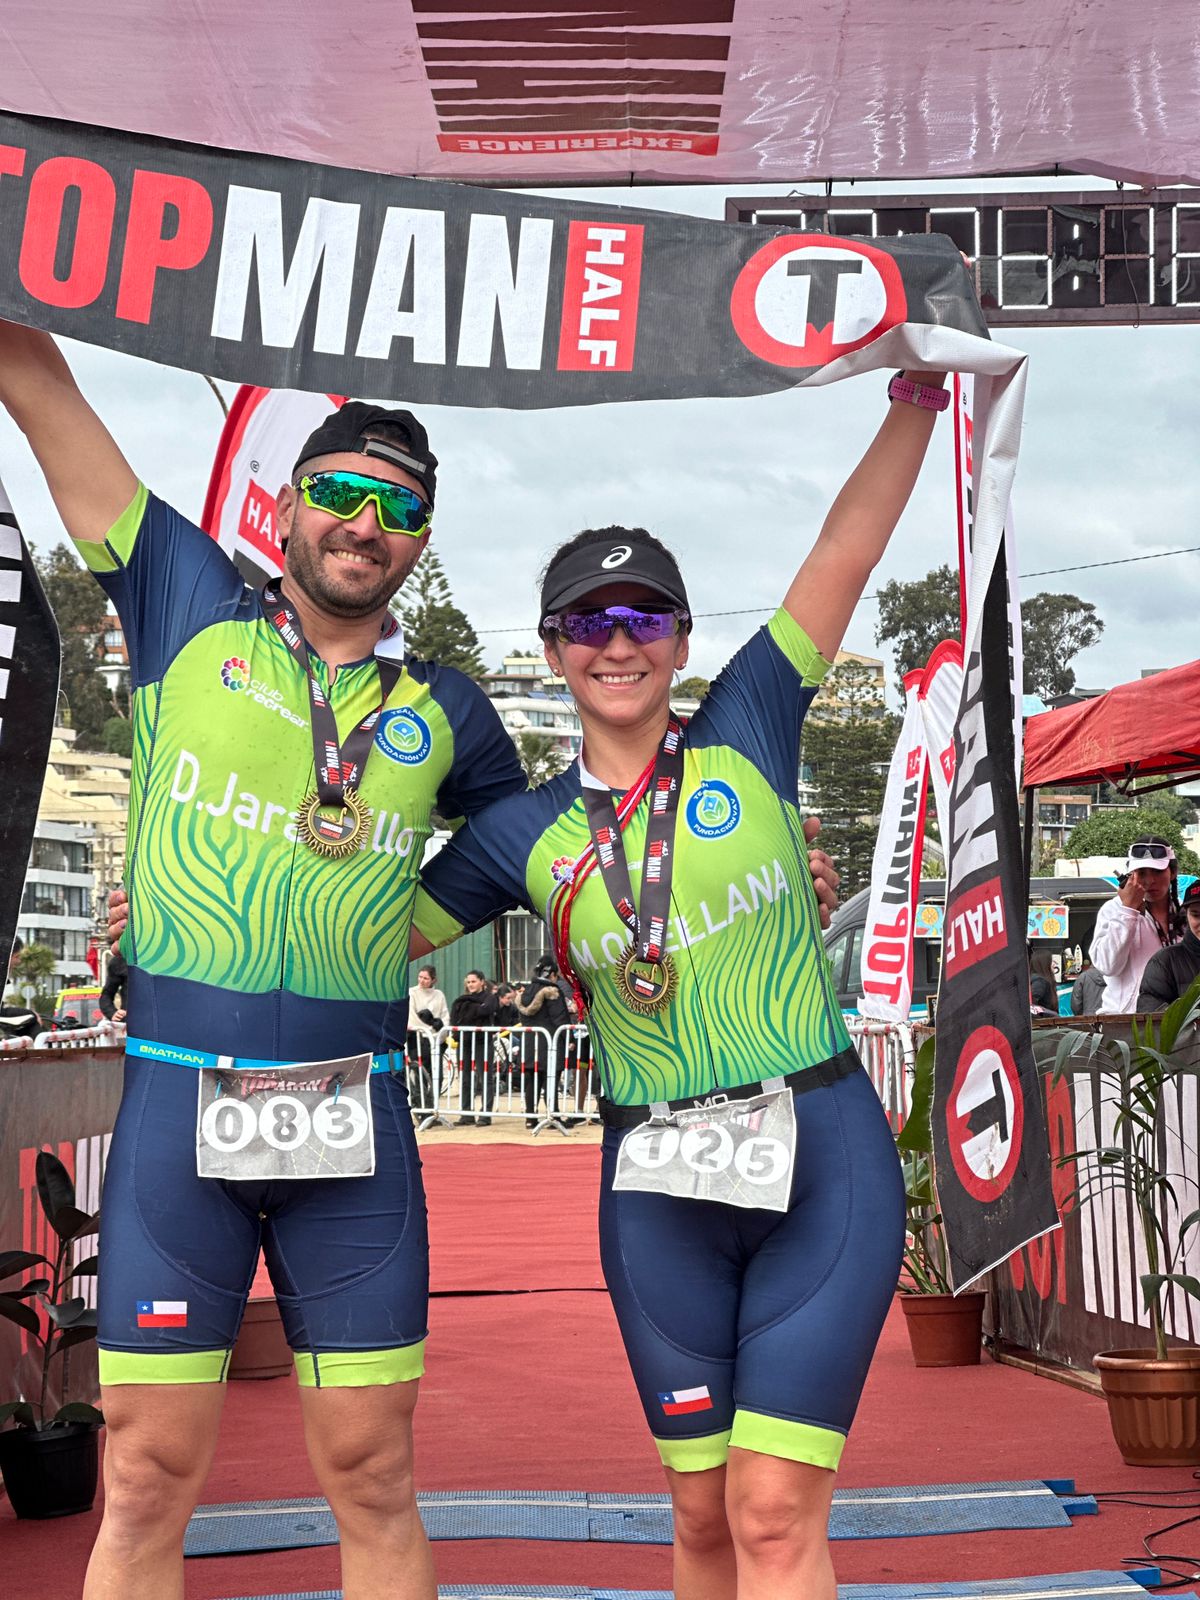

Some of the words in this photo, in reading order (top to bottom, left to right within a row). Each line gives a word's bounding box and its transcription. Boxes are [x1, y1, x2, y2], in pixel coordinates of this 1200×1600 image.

[456, 136, 693, 152] EXPERIENCE
[578, 225, 627, 368] HALF
[246, 497, 283, 550] HAL
[250, 679, 284, 702] club
[170, 748, 414, 858] D.Jarallo
[946, 895, 1005, 963] HALF
[147, 1046, 204, 1065] NATHAN
[214, 1102, 356, 1146] 083
[643, 1127, 776, 1179] 125
